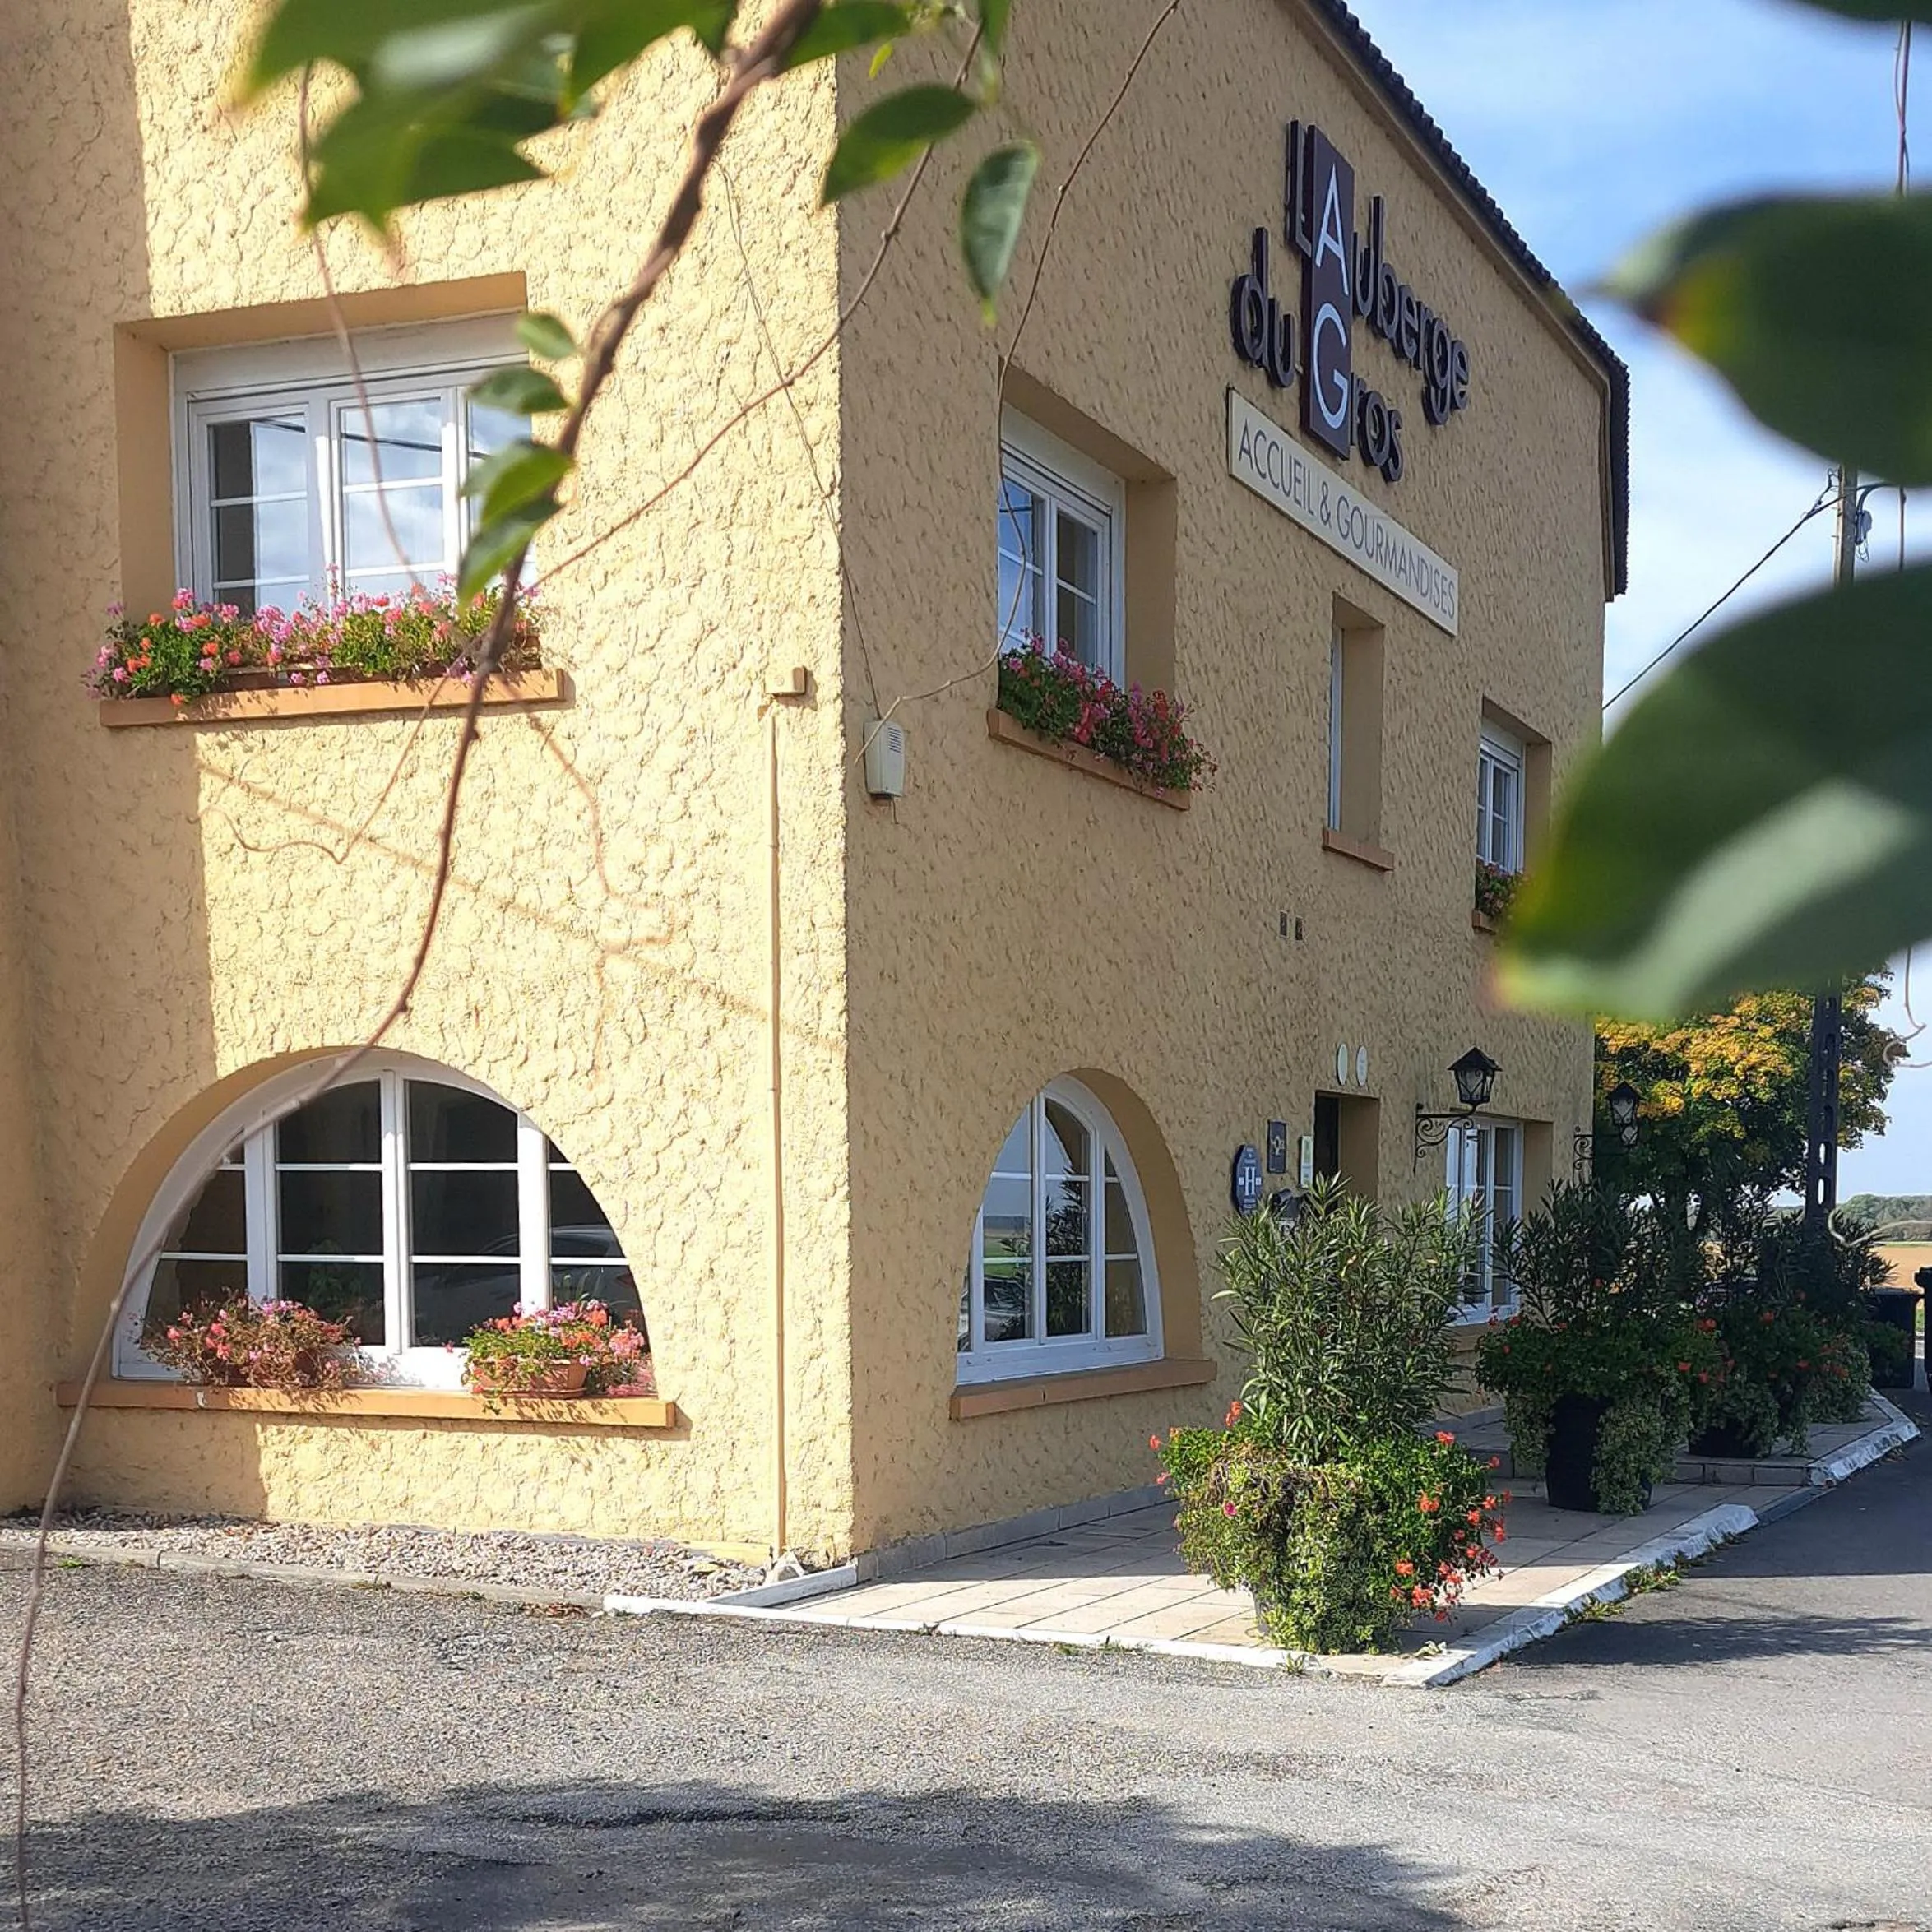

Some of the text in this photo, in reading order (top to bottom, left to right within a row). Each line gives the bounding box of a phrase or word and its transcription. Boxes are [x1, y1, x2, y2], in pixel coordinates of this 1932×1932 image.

[1231, 227, 1403, 482] du Gros
[1238, 419, 1456, 619] ACCUEIL & GOURMANDISES
[1244, 1166, 1256, 1197] H
